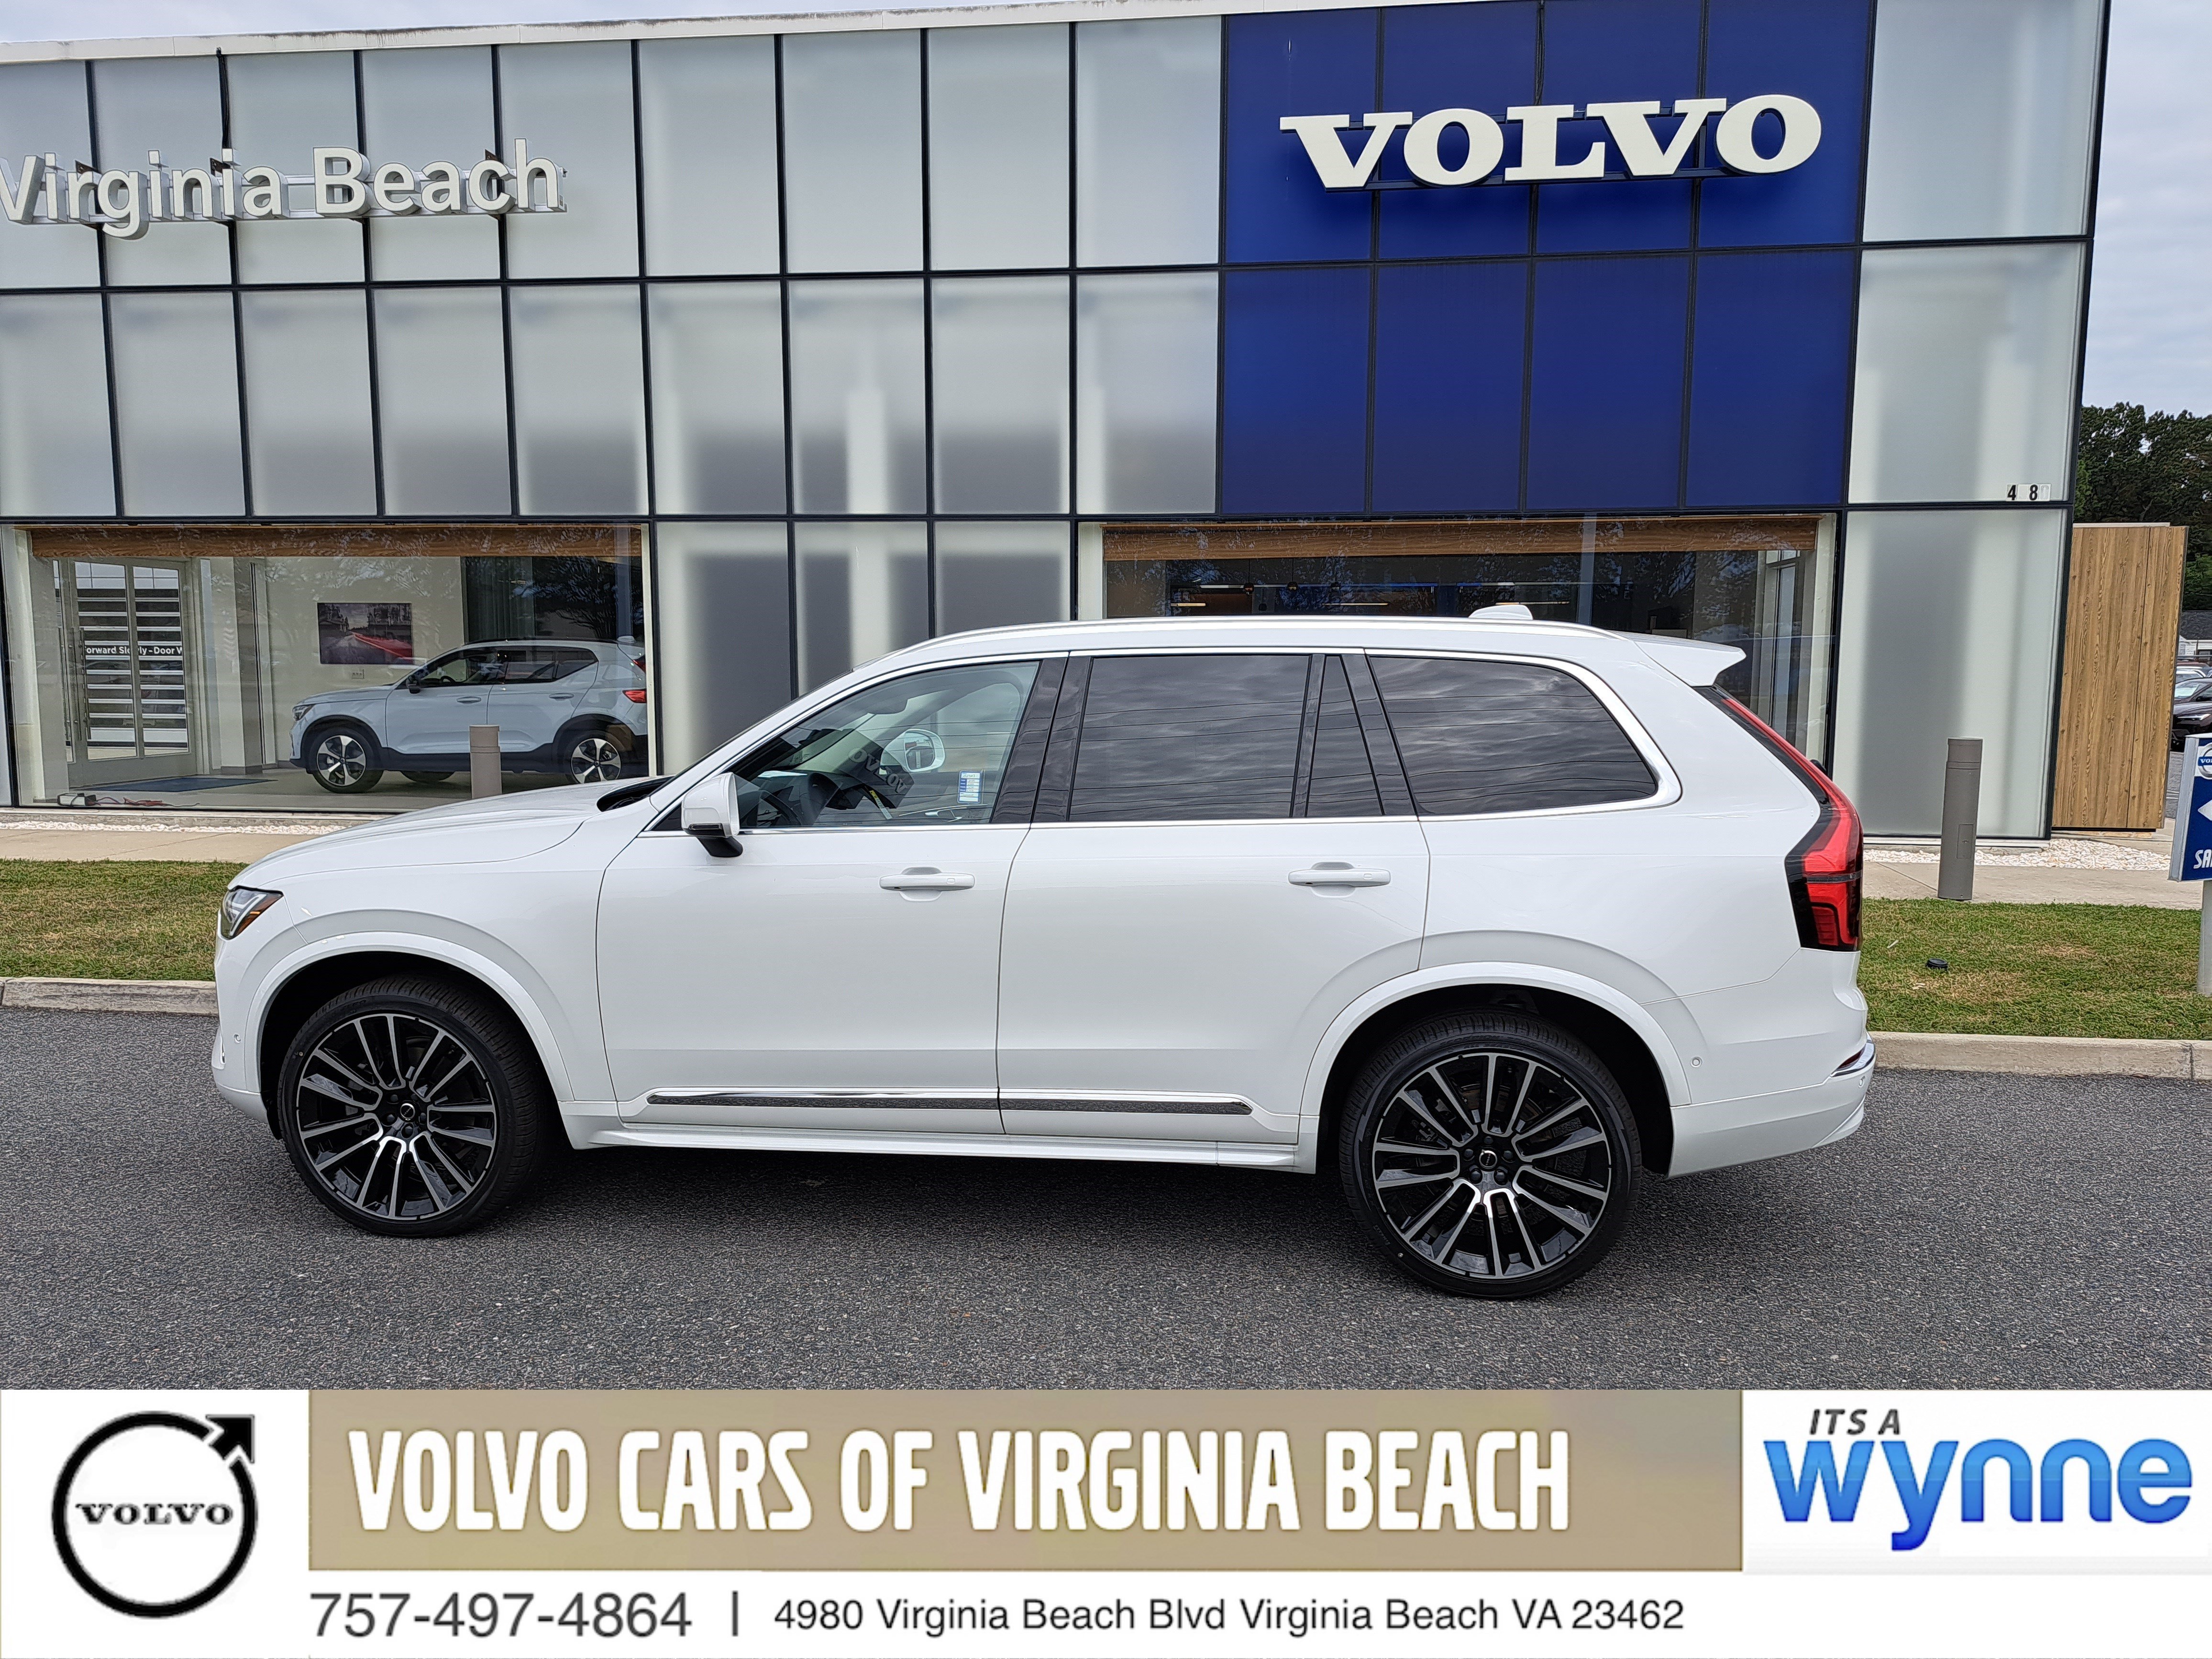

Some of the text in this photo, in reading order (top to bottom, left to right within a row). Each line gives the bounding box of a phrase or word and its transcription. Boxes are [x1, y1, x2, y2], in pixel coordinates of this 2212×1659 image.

[0, 138, 565, 238] Virginia Beach
[1279, 94, 1822, 188] VOLVO
[85, 646, 117, 654] orward
[154, 646, 174, 654] Door
